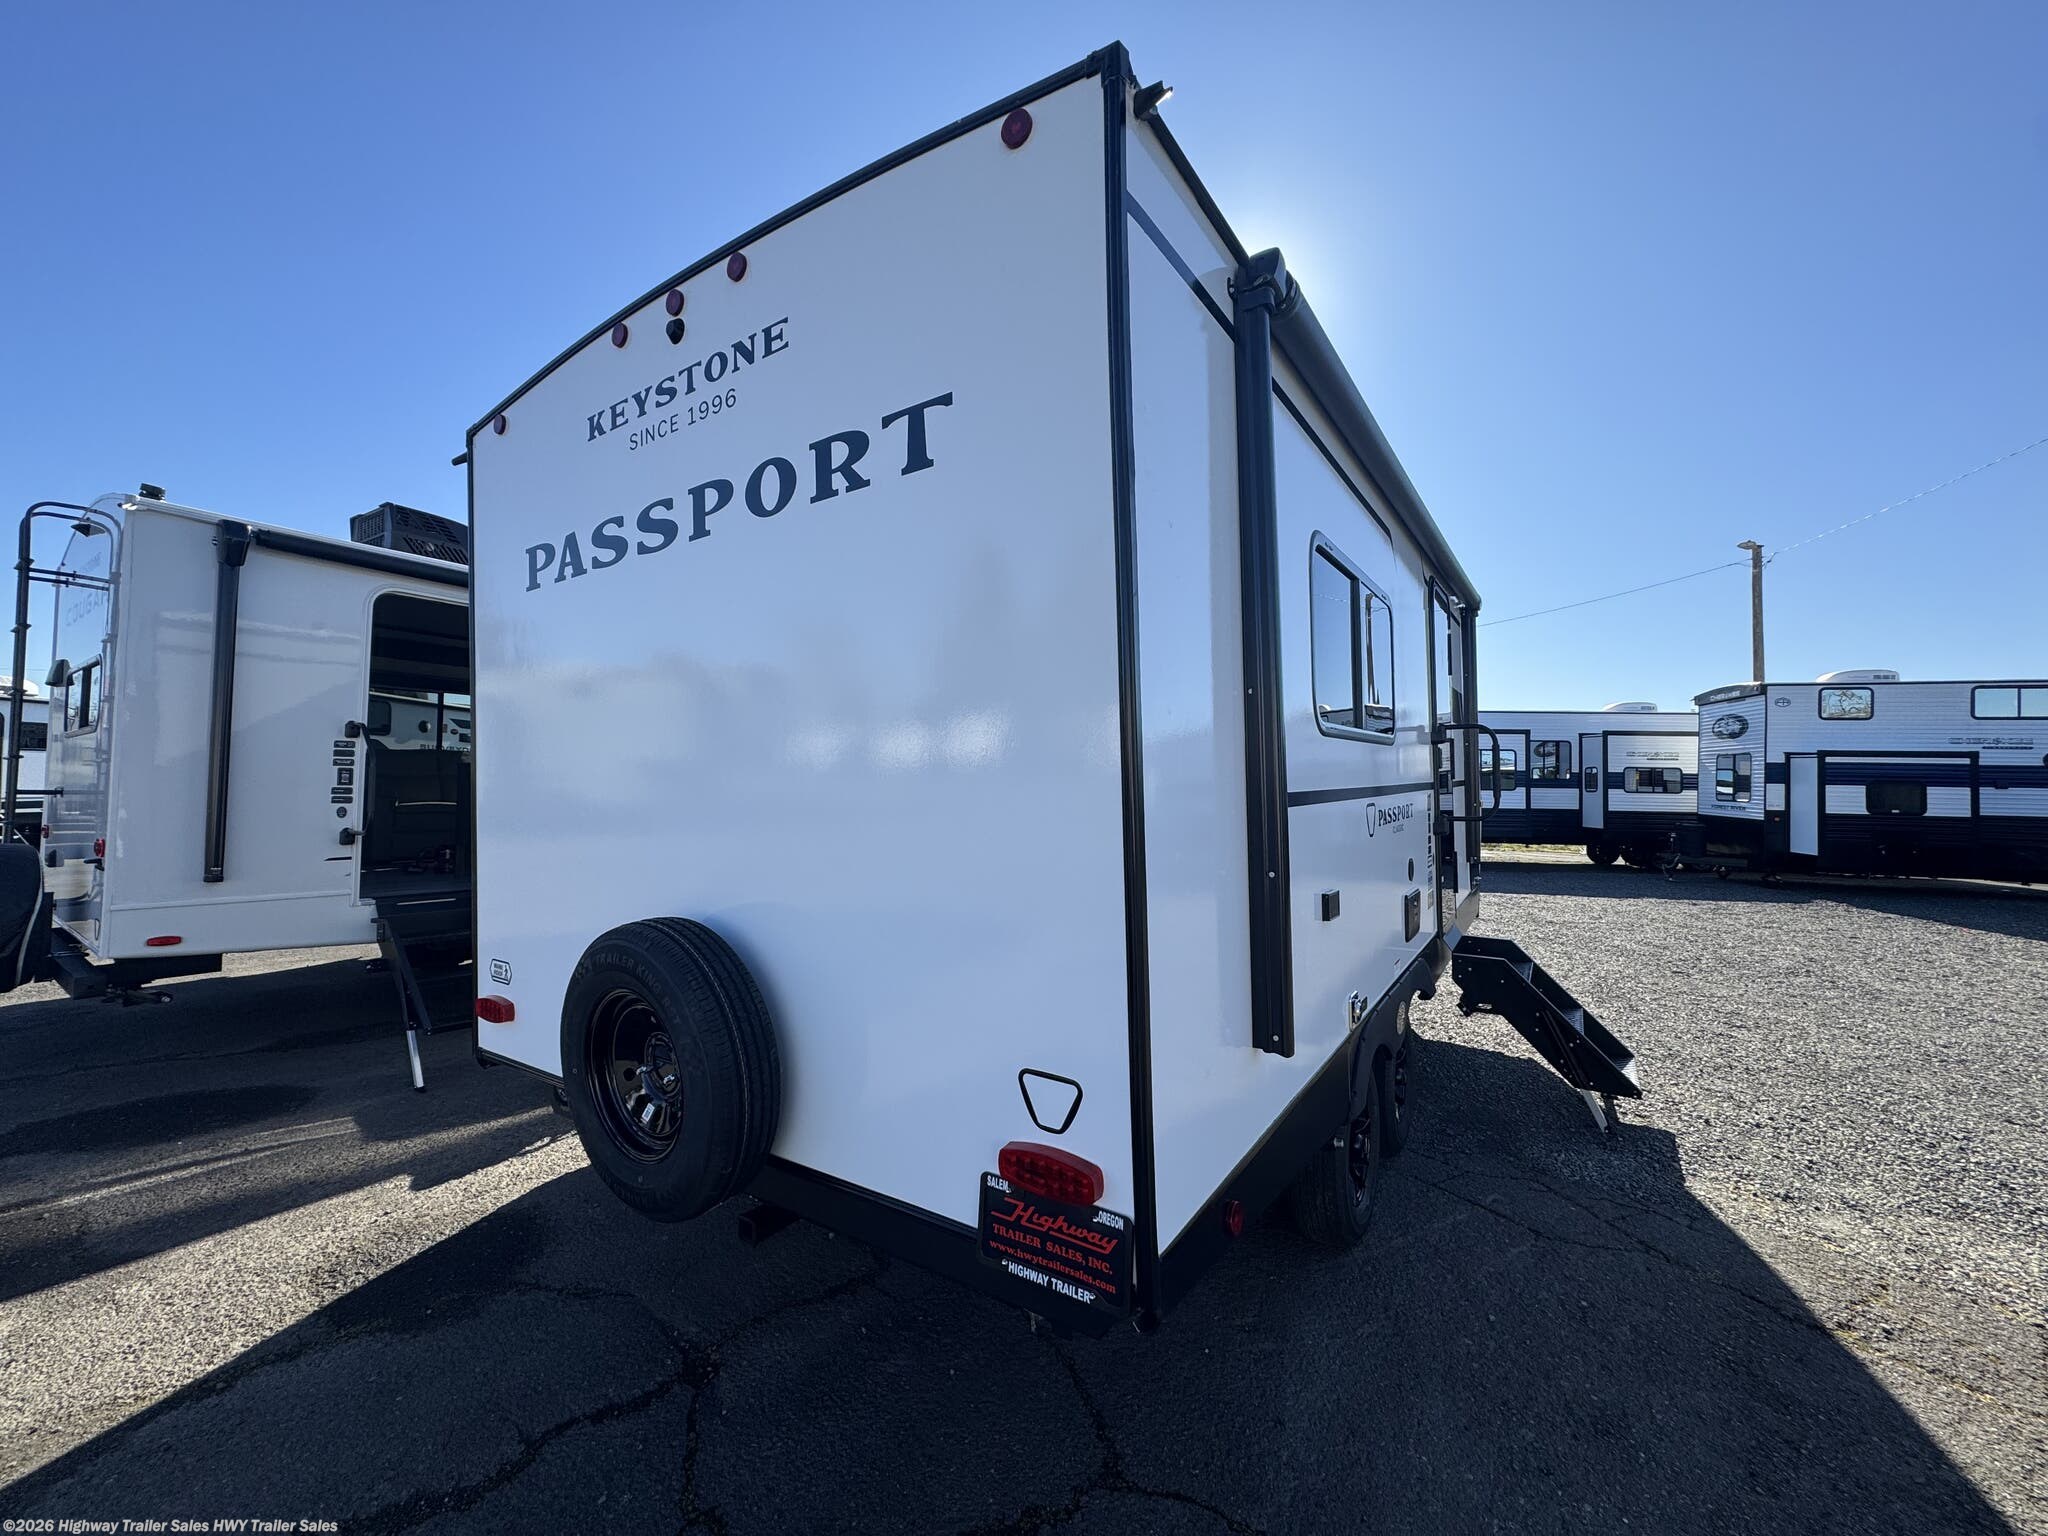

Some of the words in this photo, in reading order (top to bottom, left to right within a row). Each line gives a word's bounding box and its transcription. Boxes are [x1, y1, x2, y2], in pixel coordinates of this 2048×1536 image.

[587, 317, 790, 441] KEYSTONE
[629, 413, 679, 451] SINCE
[687, 388, 737, 426] 1996
[525, 391, 954, 593] PASSPORT
[1378, 803, 1414, 827] PASSPORT
[987, 1175, 1009, 1191] SALEM
[991, 1197, 1118, 1254] Highway
[1098, 1210, 1124, 1231] OREGON
[989, 1240, 1116, 1294] www.hwytrailersales.com
[993, 1223, 1041, 1248] TRAILER
[1046, 1241, 1086, 1266] SALES,
[1087, 1256, 1113, 1275] INC.
[1008, 1261, 1049, 1287] HIGHWAY
[1051, 1277, 1091, 1304] TRAILER
